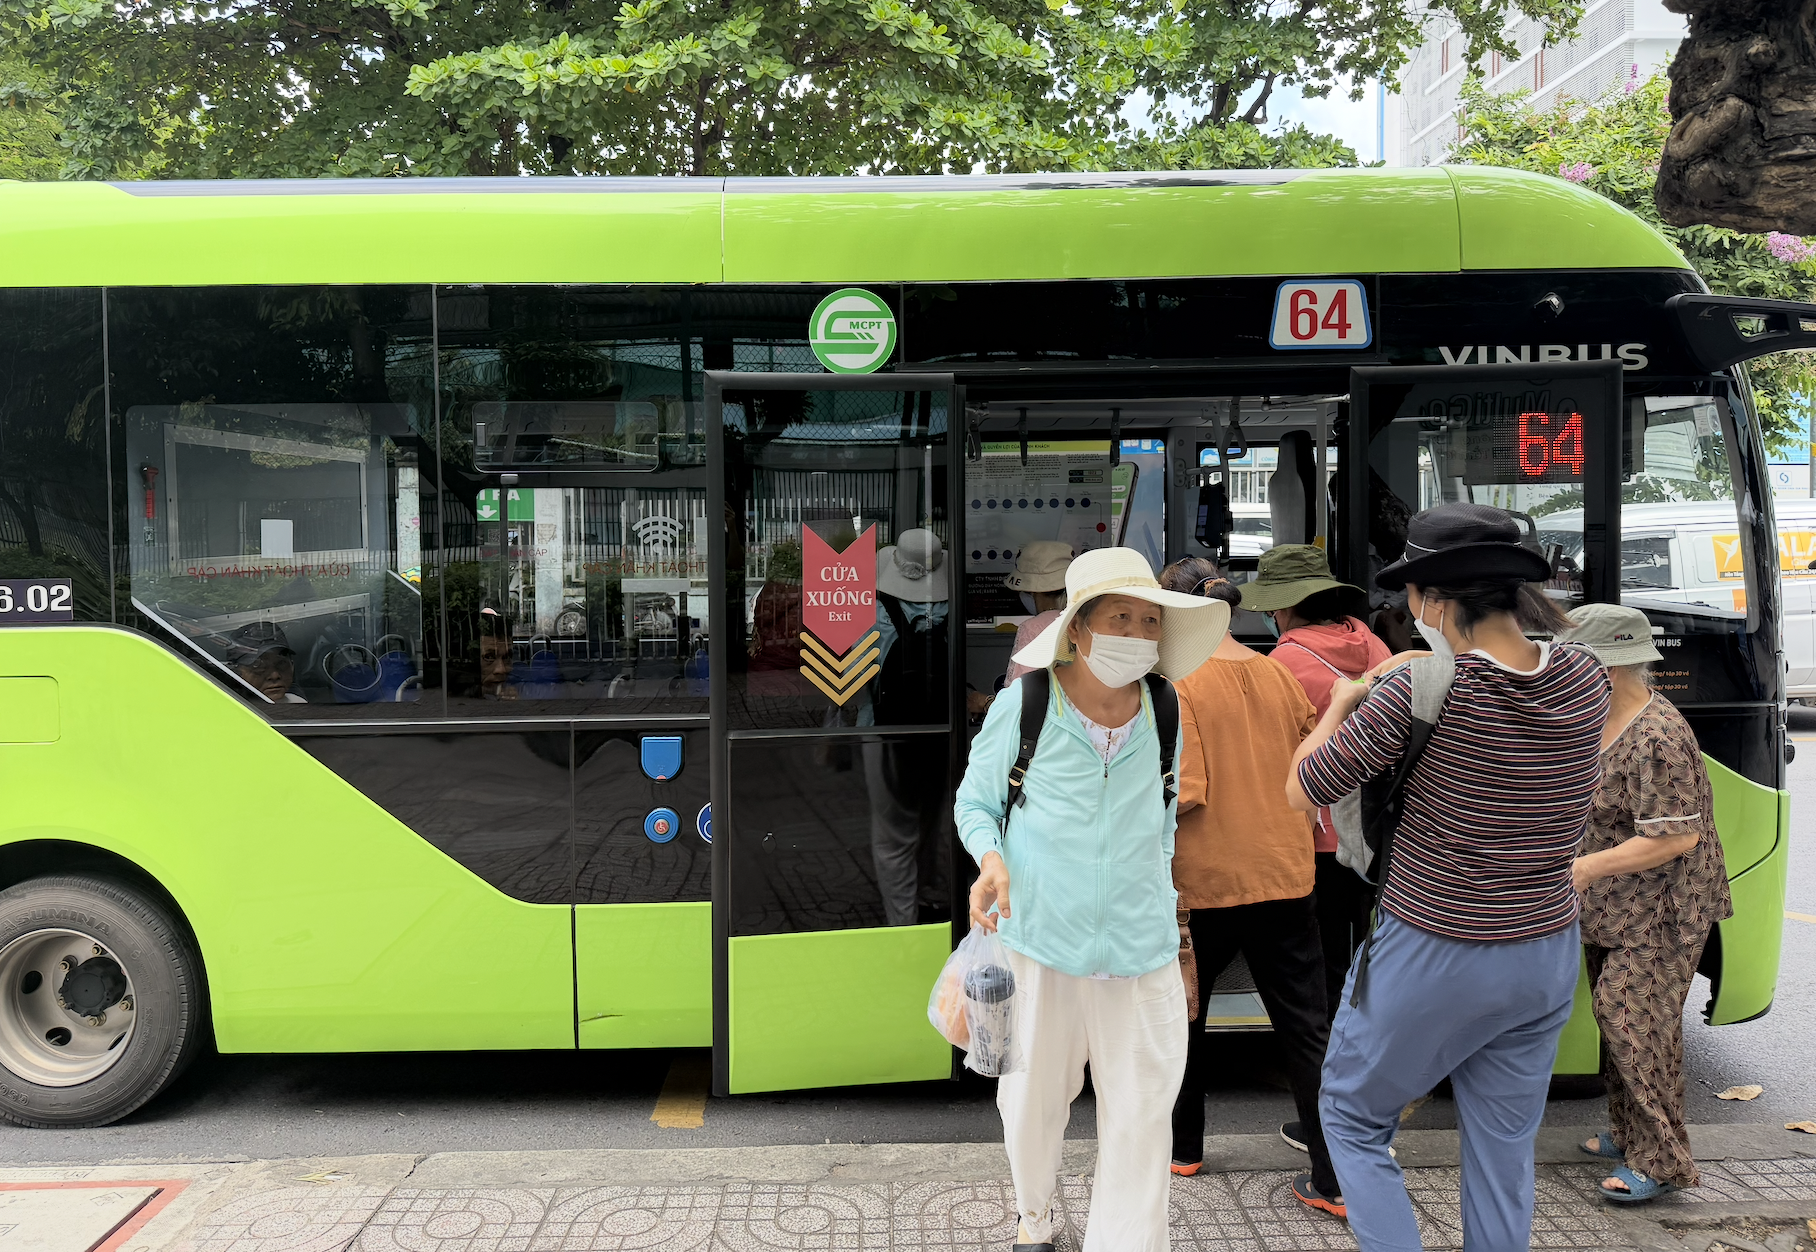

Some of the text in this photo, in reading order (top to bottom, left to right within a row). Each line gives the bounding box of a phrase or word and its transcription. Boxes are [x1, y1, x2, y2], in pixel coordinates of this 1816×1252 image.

[1289, 288, 1352, 340] 64
[849, 321, 882, 330] MCPT
[1438, 343, 1649, 371] VINBUS
[1518, 412, 1585, 476] 64
[820, 562, 859, 582] CỬA
[0, 585, 72, 613] 6.02
[806, 586, 873, 607] XUỐNG
[828, 611, 852, 622] Exit
[1614, 633, 1634, 642] FILA
[1652, 638, 1682, 647] VIN BUS
